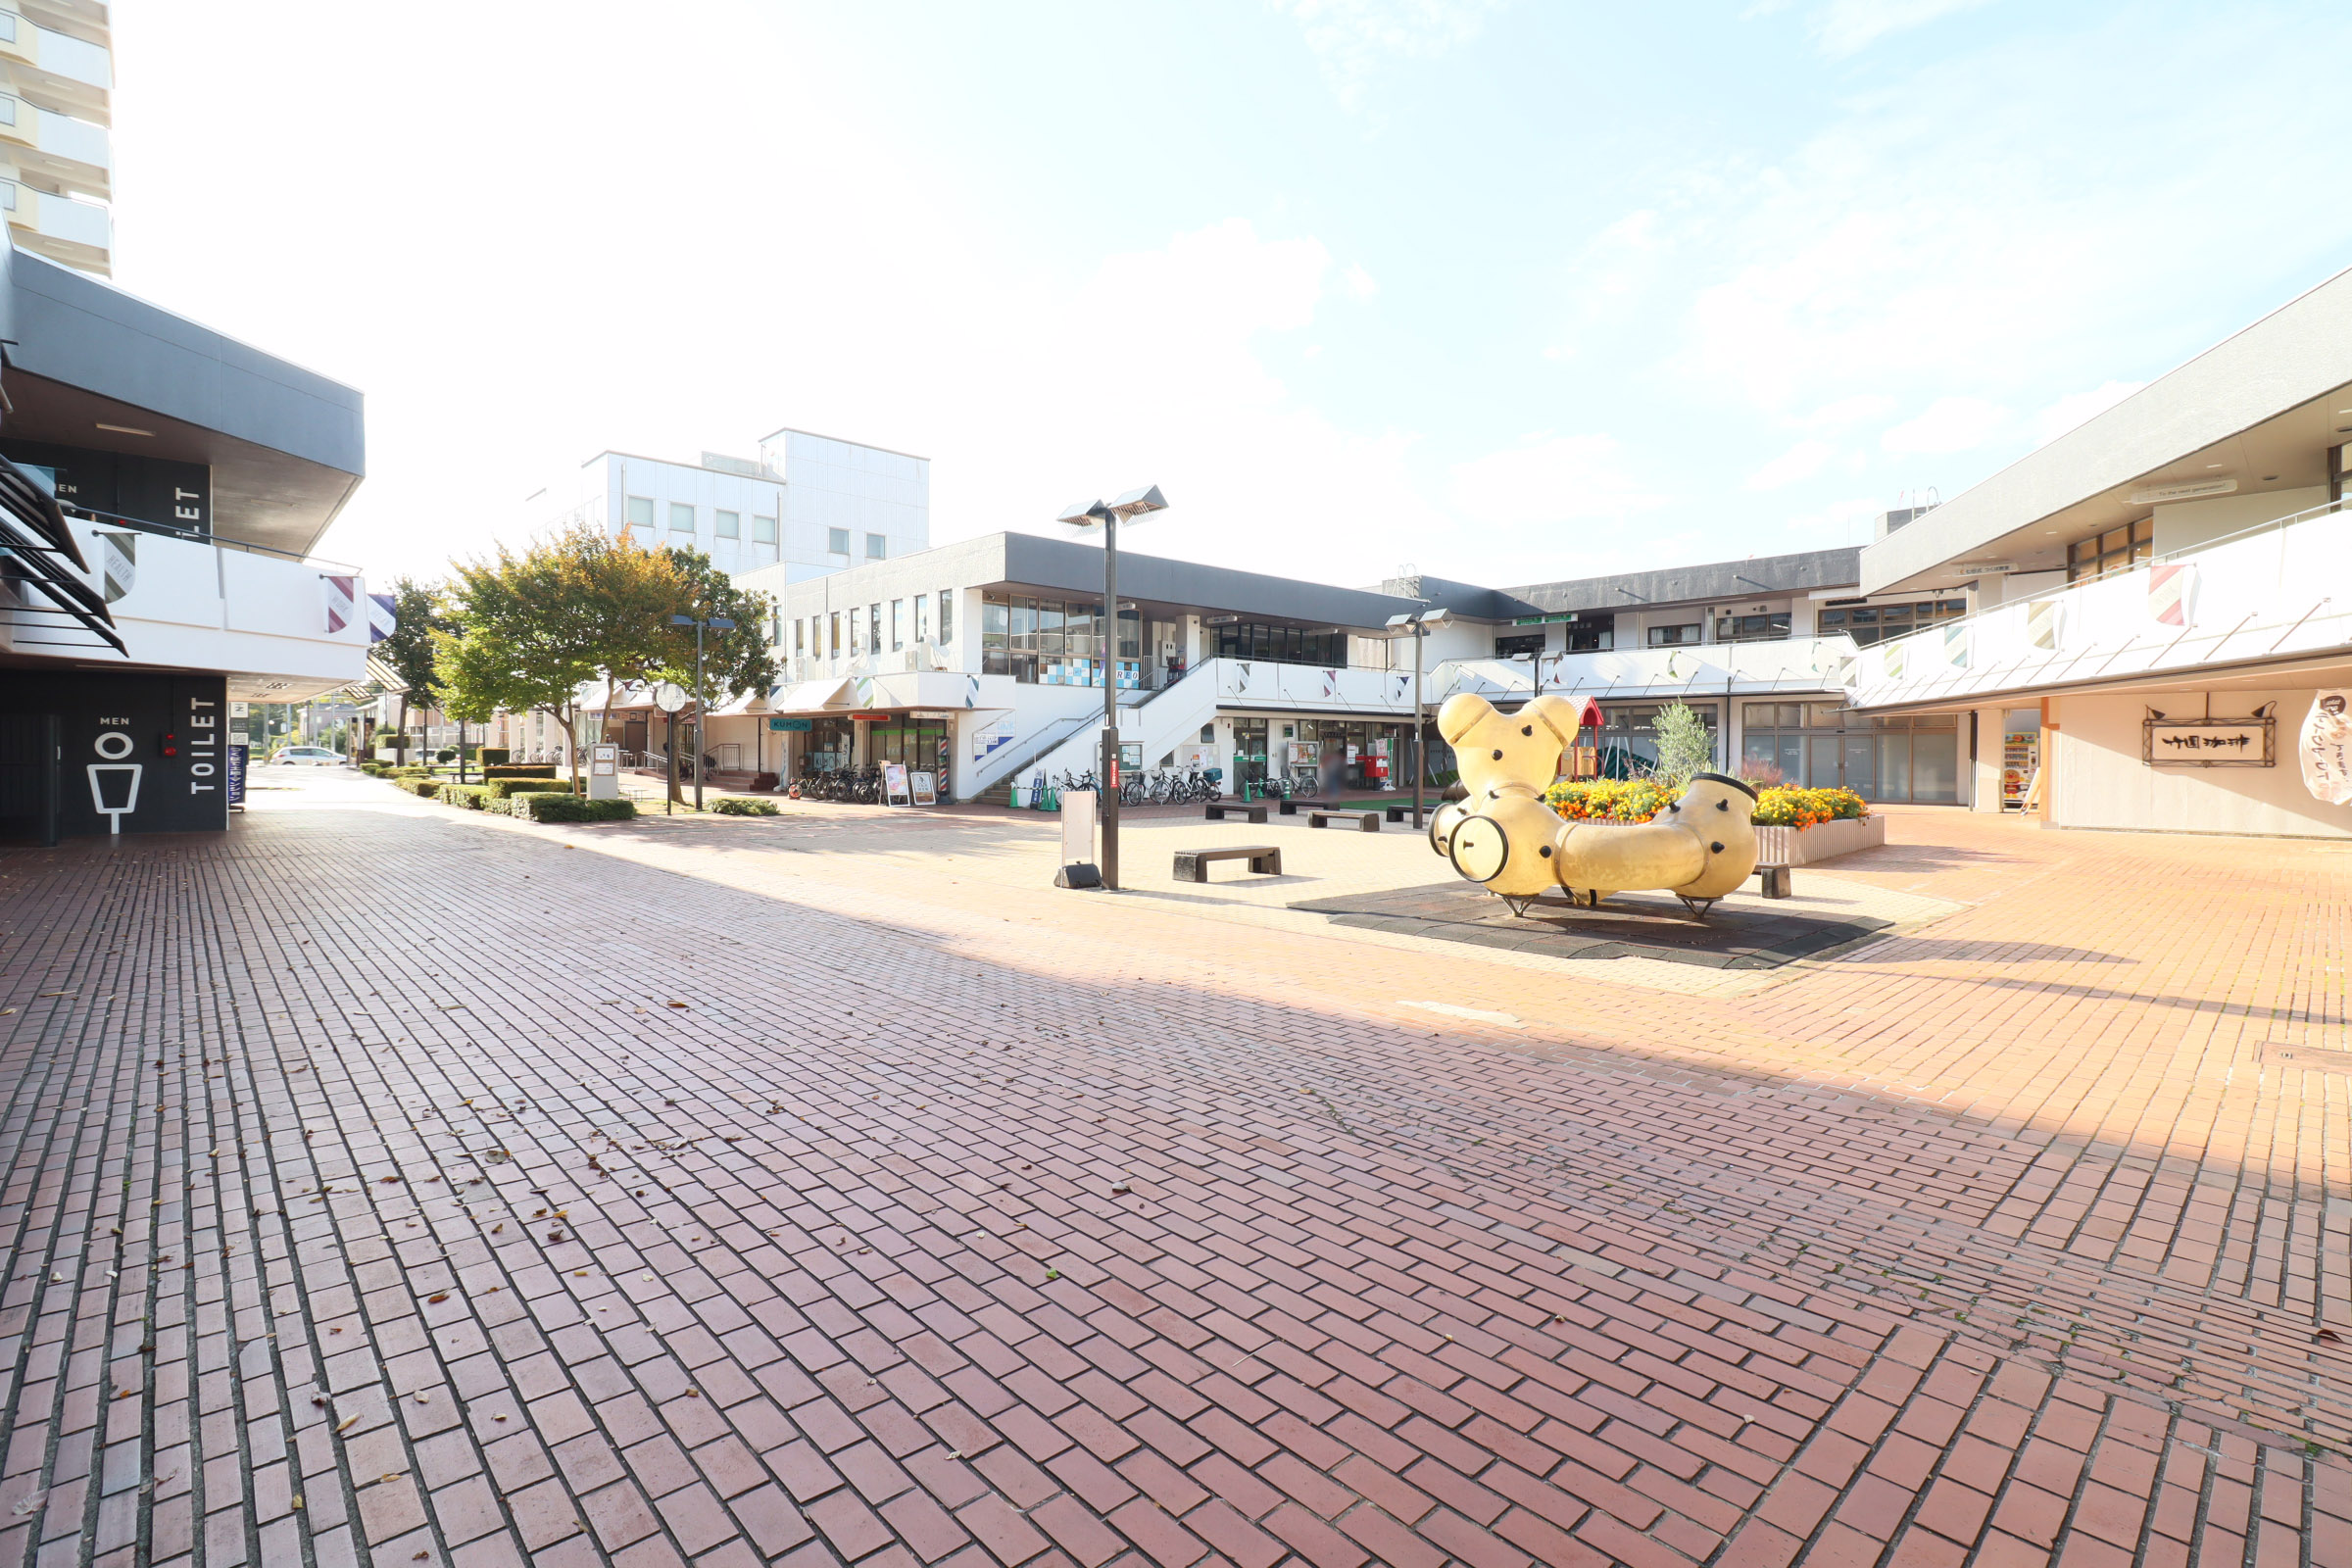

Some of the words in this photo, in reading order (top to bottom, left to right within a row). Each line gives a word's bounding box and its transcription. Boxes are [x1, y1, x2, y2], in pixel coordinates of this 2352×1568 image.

[55, 483, 77, 493] EN
[175, 486, 200, 538] LET
[106, 555, 133, 582] HEALTH
[100, 716, 129, 725] MEN
[773, 719, 808, 729] KUMON
[191, 697, 215, 795] TOILET
